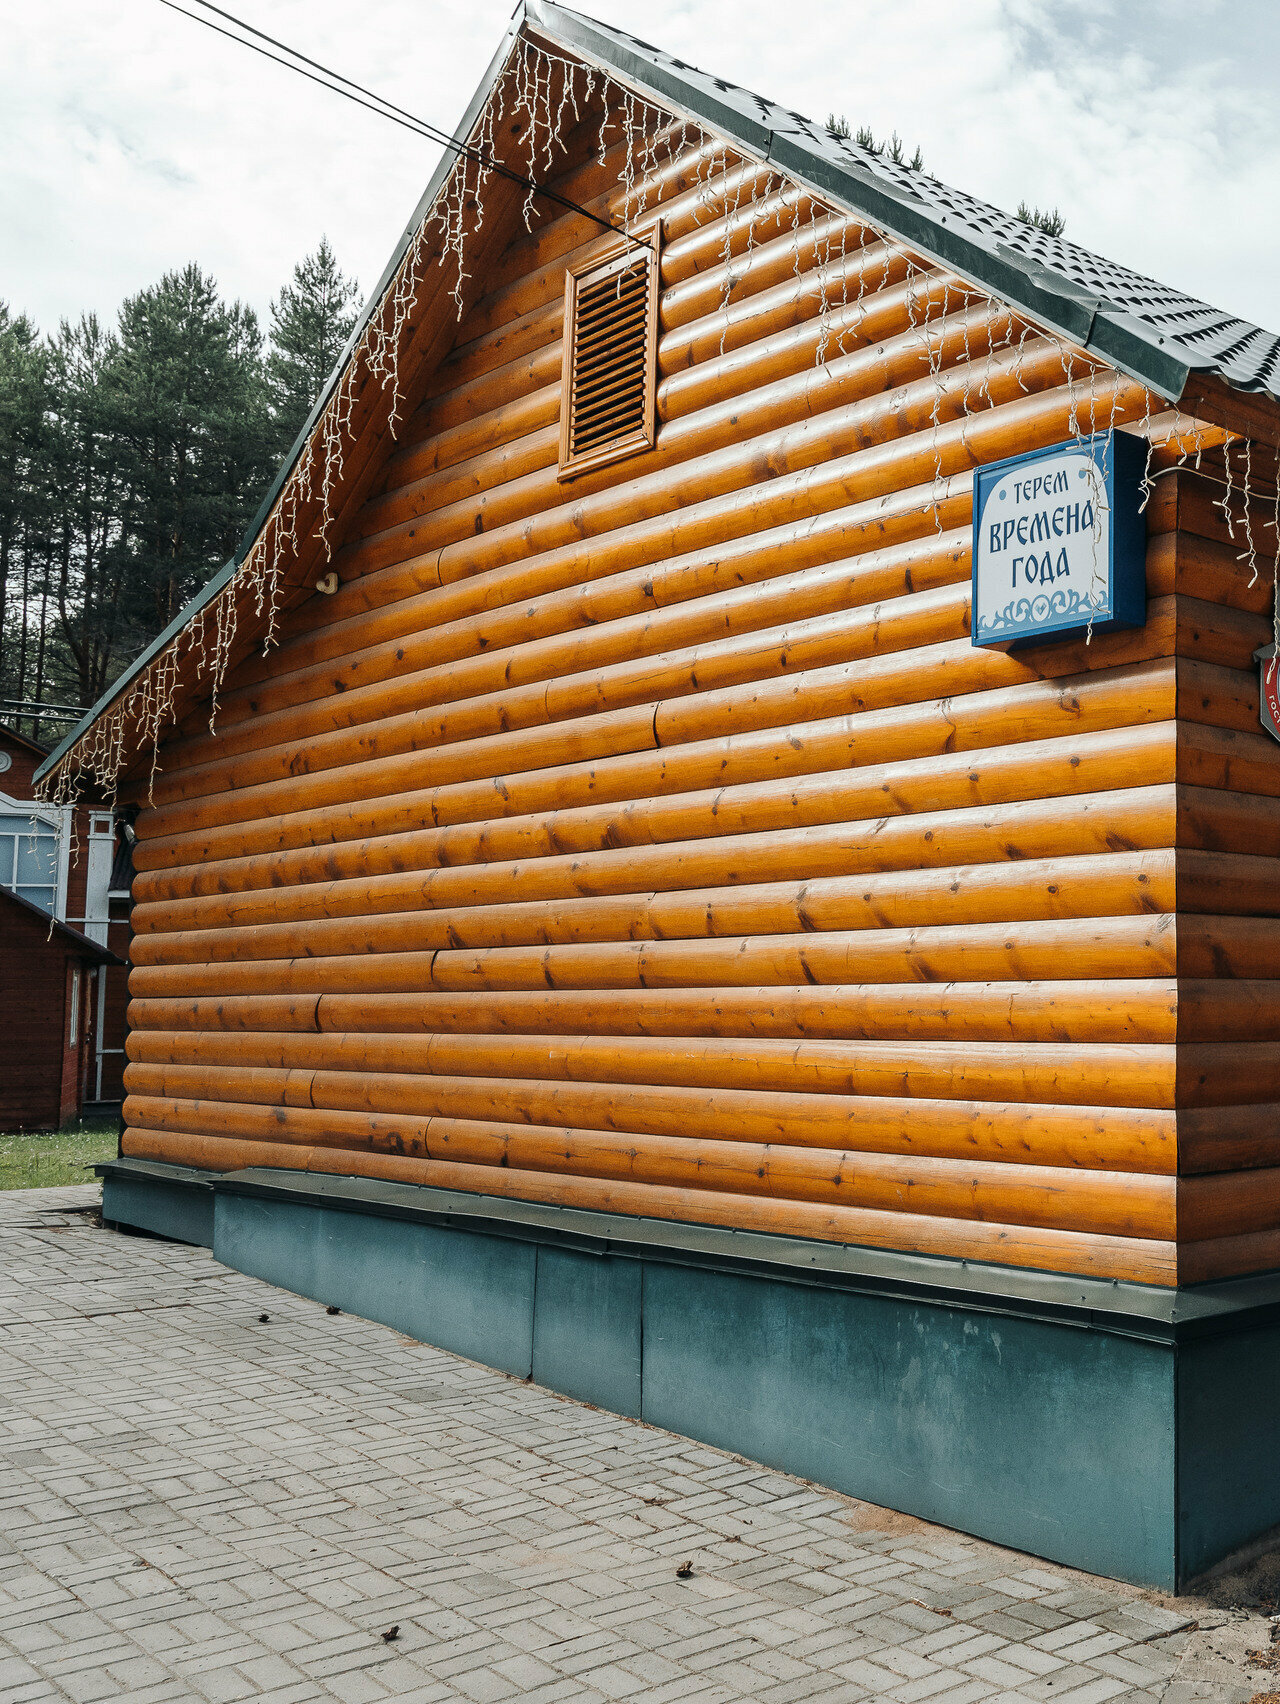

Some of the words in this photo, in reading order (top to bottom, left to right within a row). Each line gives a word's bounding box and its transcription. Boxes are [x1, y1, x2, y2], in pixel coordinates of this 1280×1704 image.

[1014, 470, 1069, 504] ТЕРЕМ
[990, 500, 1094, 553] ВРЕМЕНА
[1012, 547, 1070, 588] ГОДА
